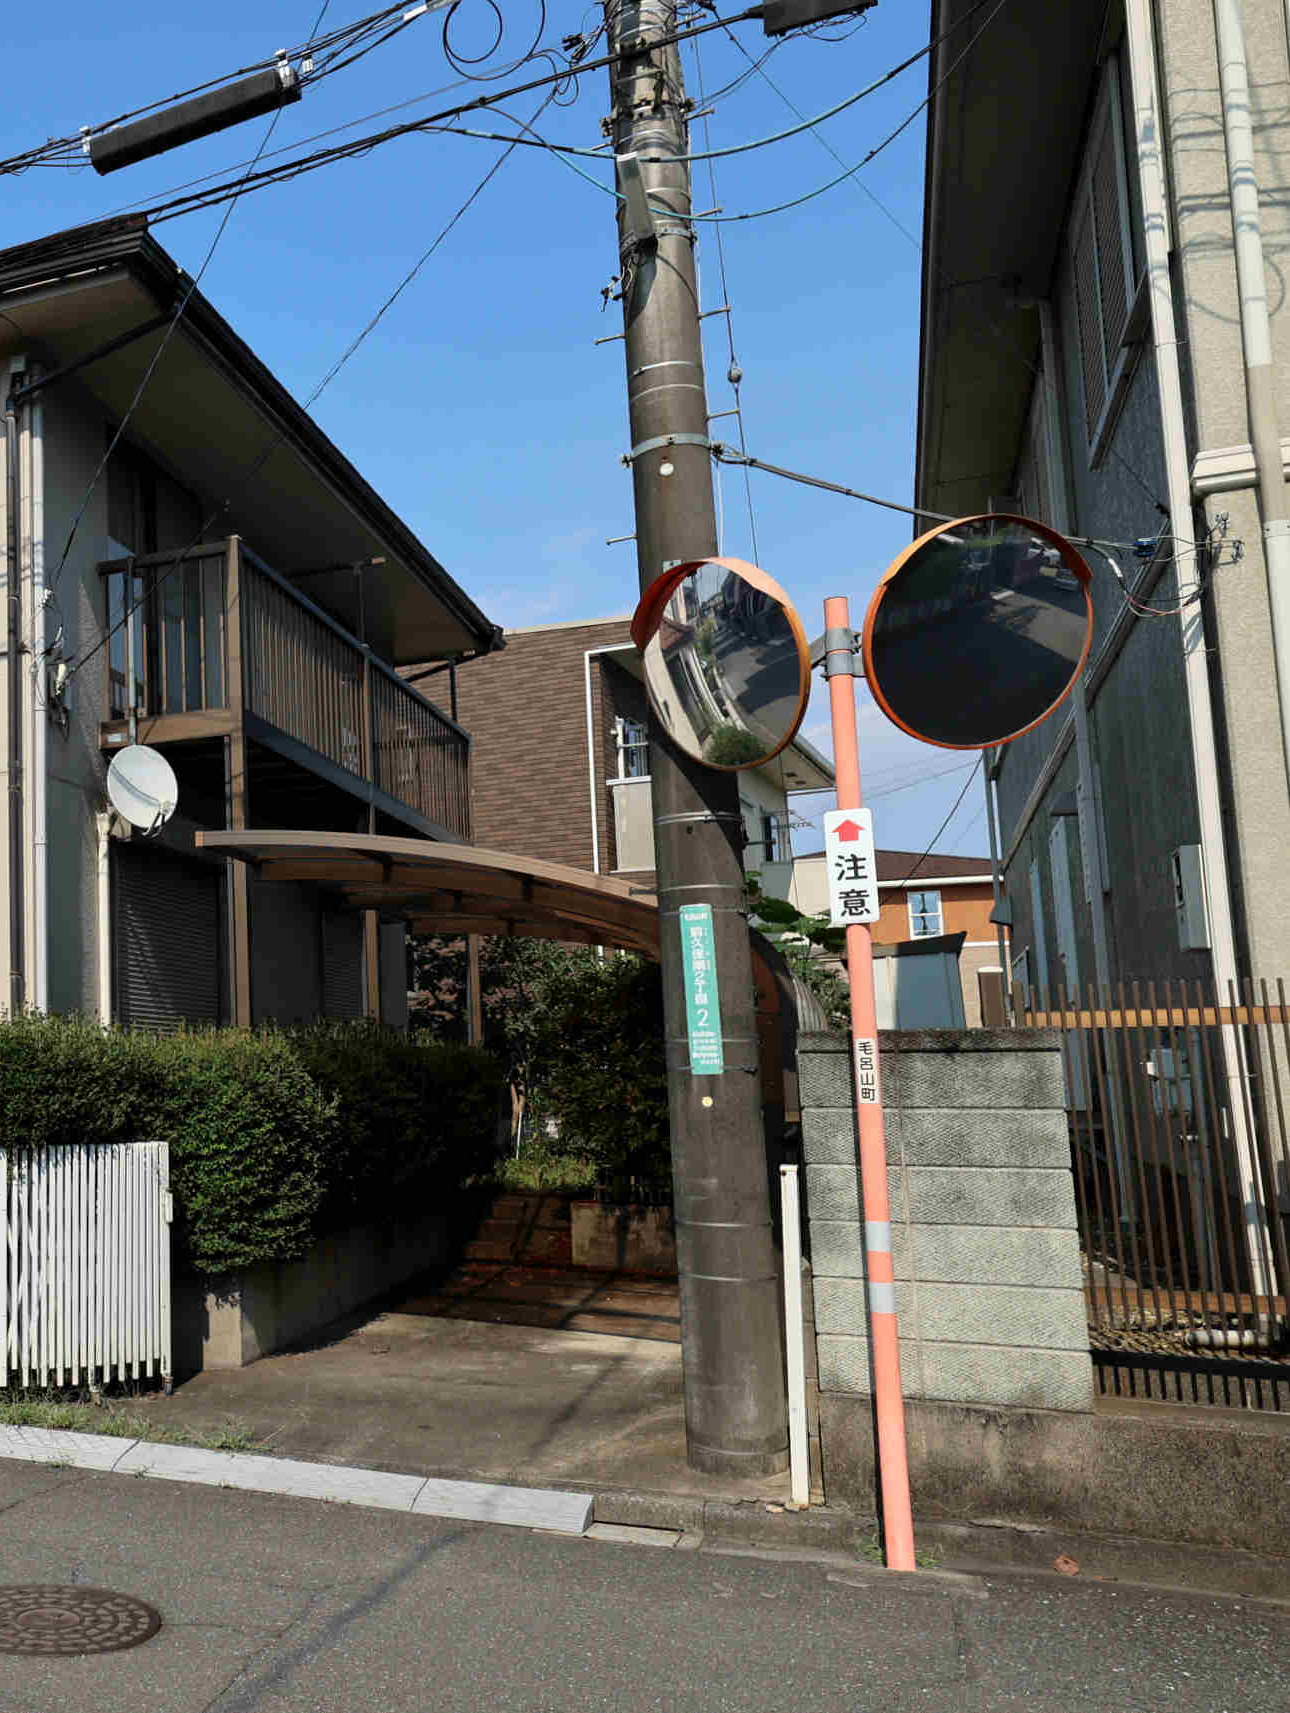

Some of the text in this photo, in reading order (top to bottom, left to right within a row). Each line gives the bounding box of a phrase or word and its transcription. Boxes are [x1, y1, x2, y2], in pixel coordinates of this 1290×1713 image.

[835, 853, 871, 917] 注意
[697, 1008, 710, 1027] 2
[858, 1041, 876, 1101] 毛呂山町
